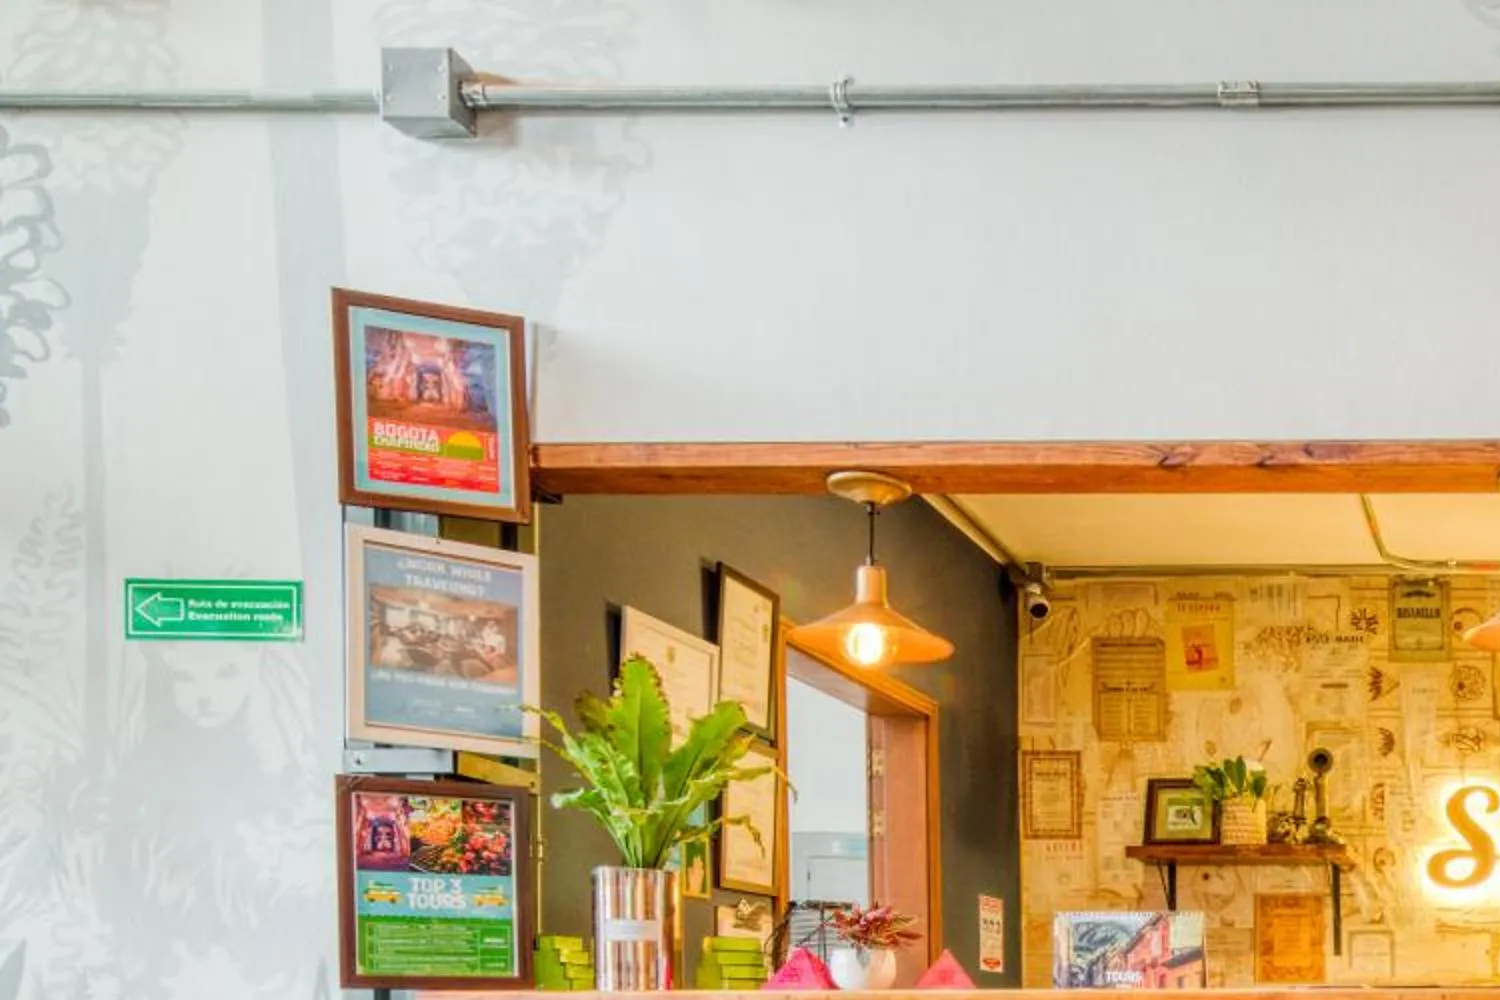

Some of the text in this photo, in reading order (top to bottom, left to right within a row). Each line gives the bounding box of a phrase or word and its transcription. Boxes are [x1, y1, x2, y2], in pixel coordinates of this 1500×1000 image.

[215, 599, 229, 609] de
[188, 611, 251, 621] Evacuation
[408, 877, 464, 893] TOP 3
[407, 893, 467, 911] TOURS
